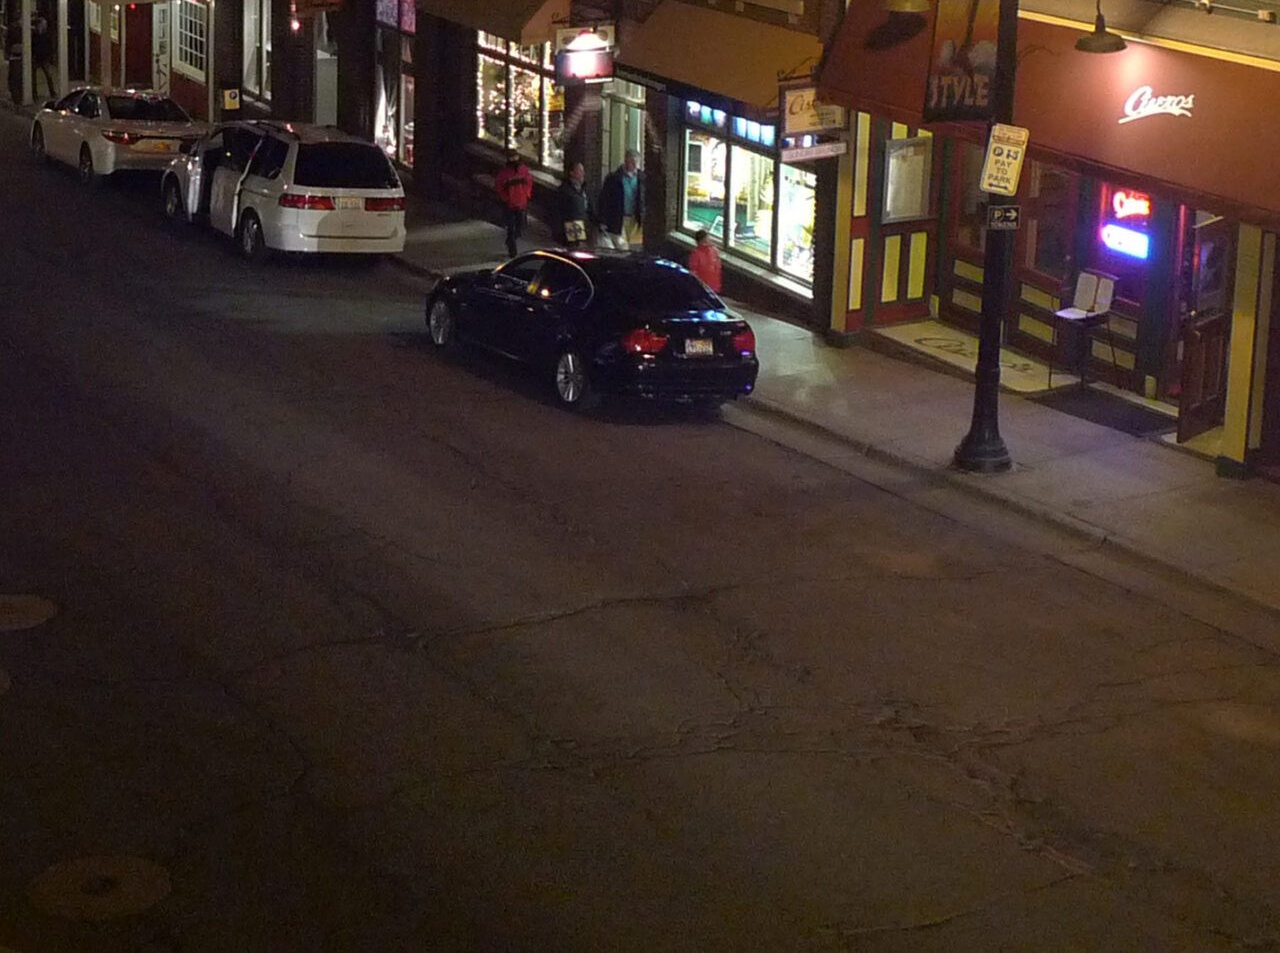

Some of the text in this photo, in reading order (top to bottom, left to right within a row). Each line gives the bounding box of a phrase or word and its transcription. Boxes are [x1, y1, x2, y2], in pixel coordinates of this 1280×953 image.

[994, 159, 1013, 168] PAY
[996, 167, 1008, 175] TO
[987, 173, 1011, 184] PARK
